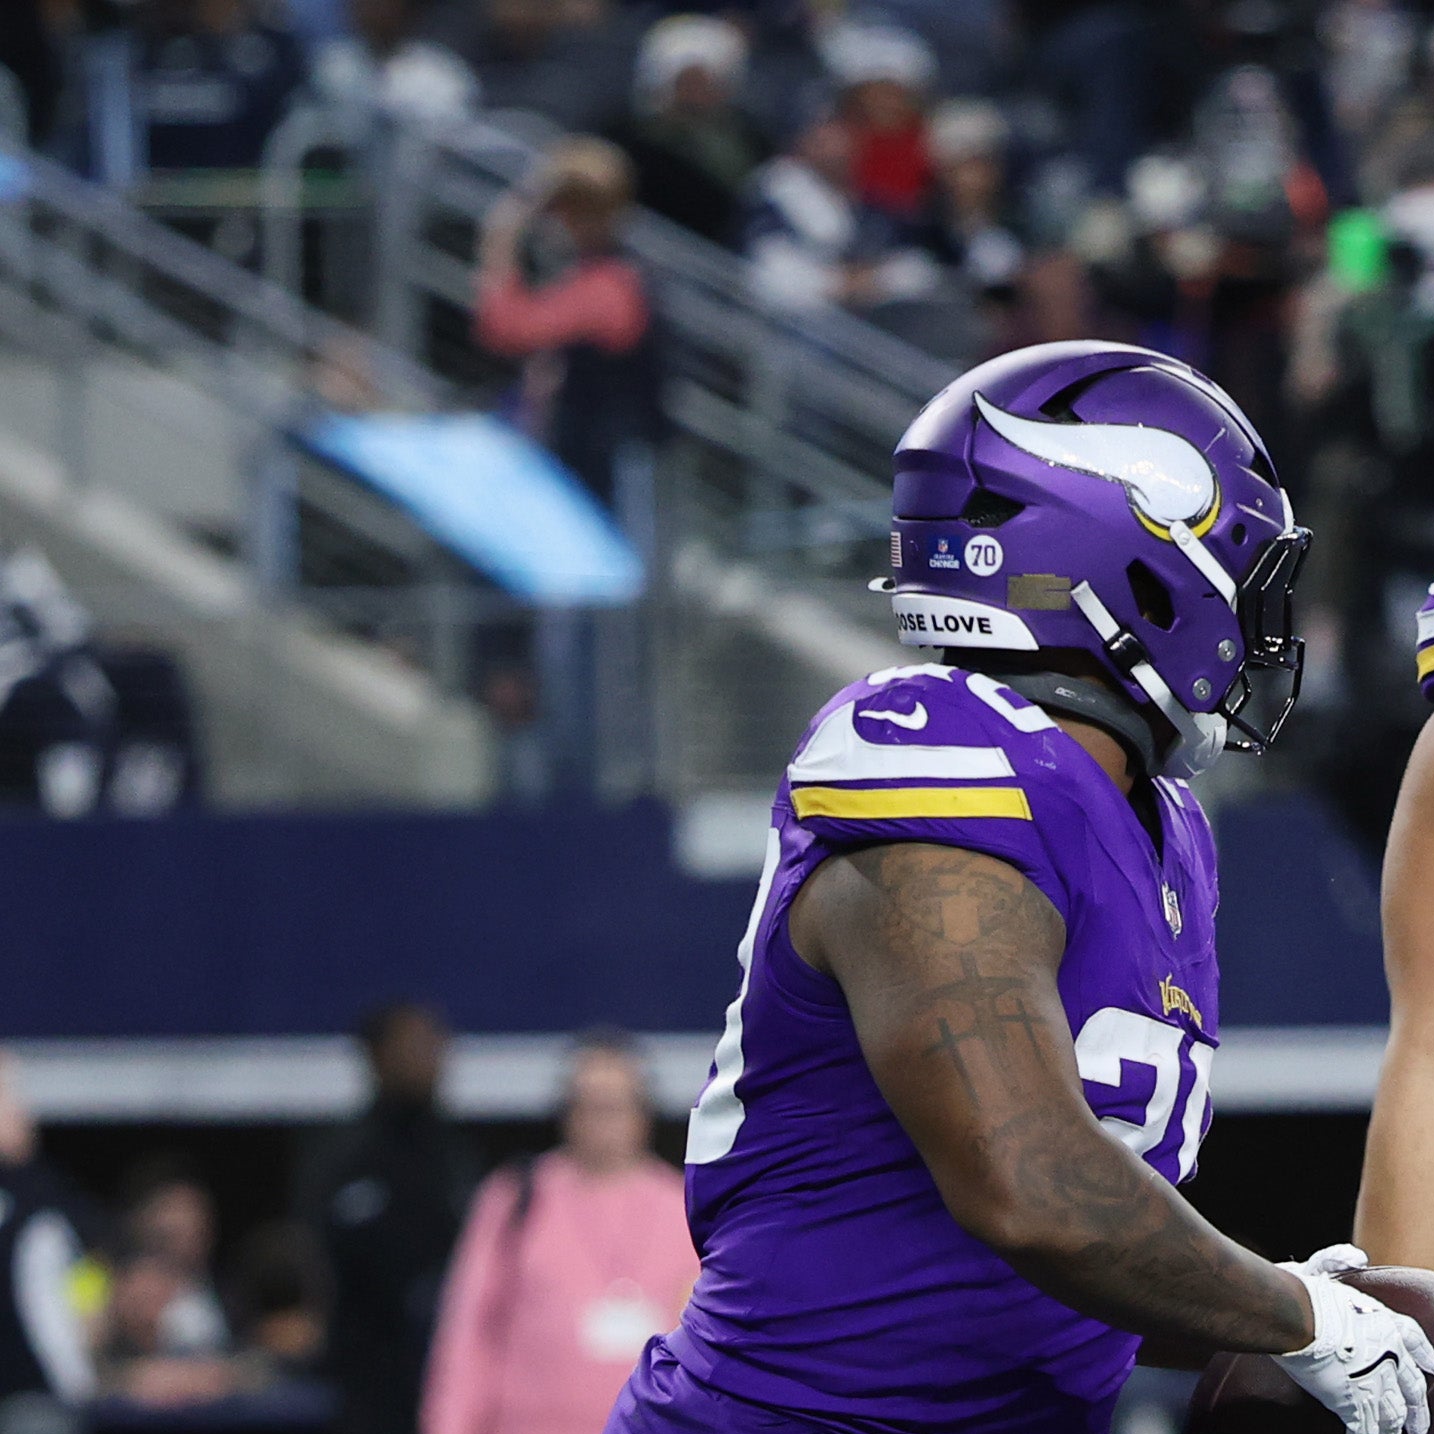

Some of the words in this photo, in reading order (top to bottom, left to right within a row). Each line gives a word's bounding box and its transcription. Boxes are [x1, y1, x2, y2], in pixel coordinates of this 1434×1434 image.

[970, 544, 996, 567] 70
[931, 614, 993, 634] LOVE
[1074, 1006, 1214, 1184] 2
